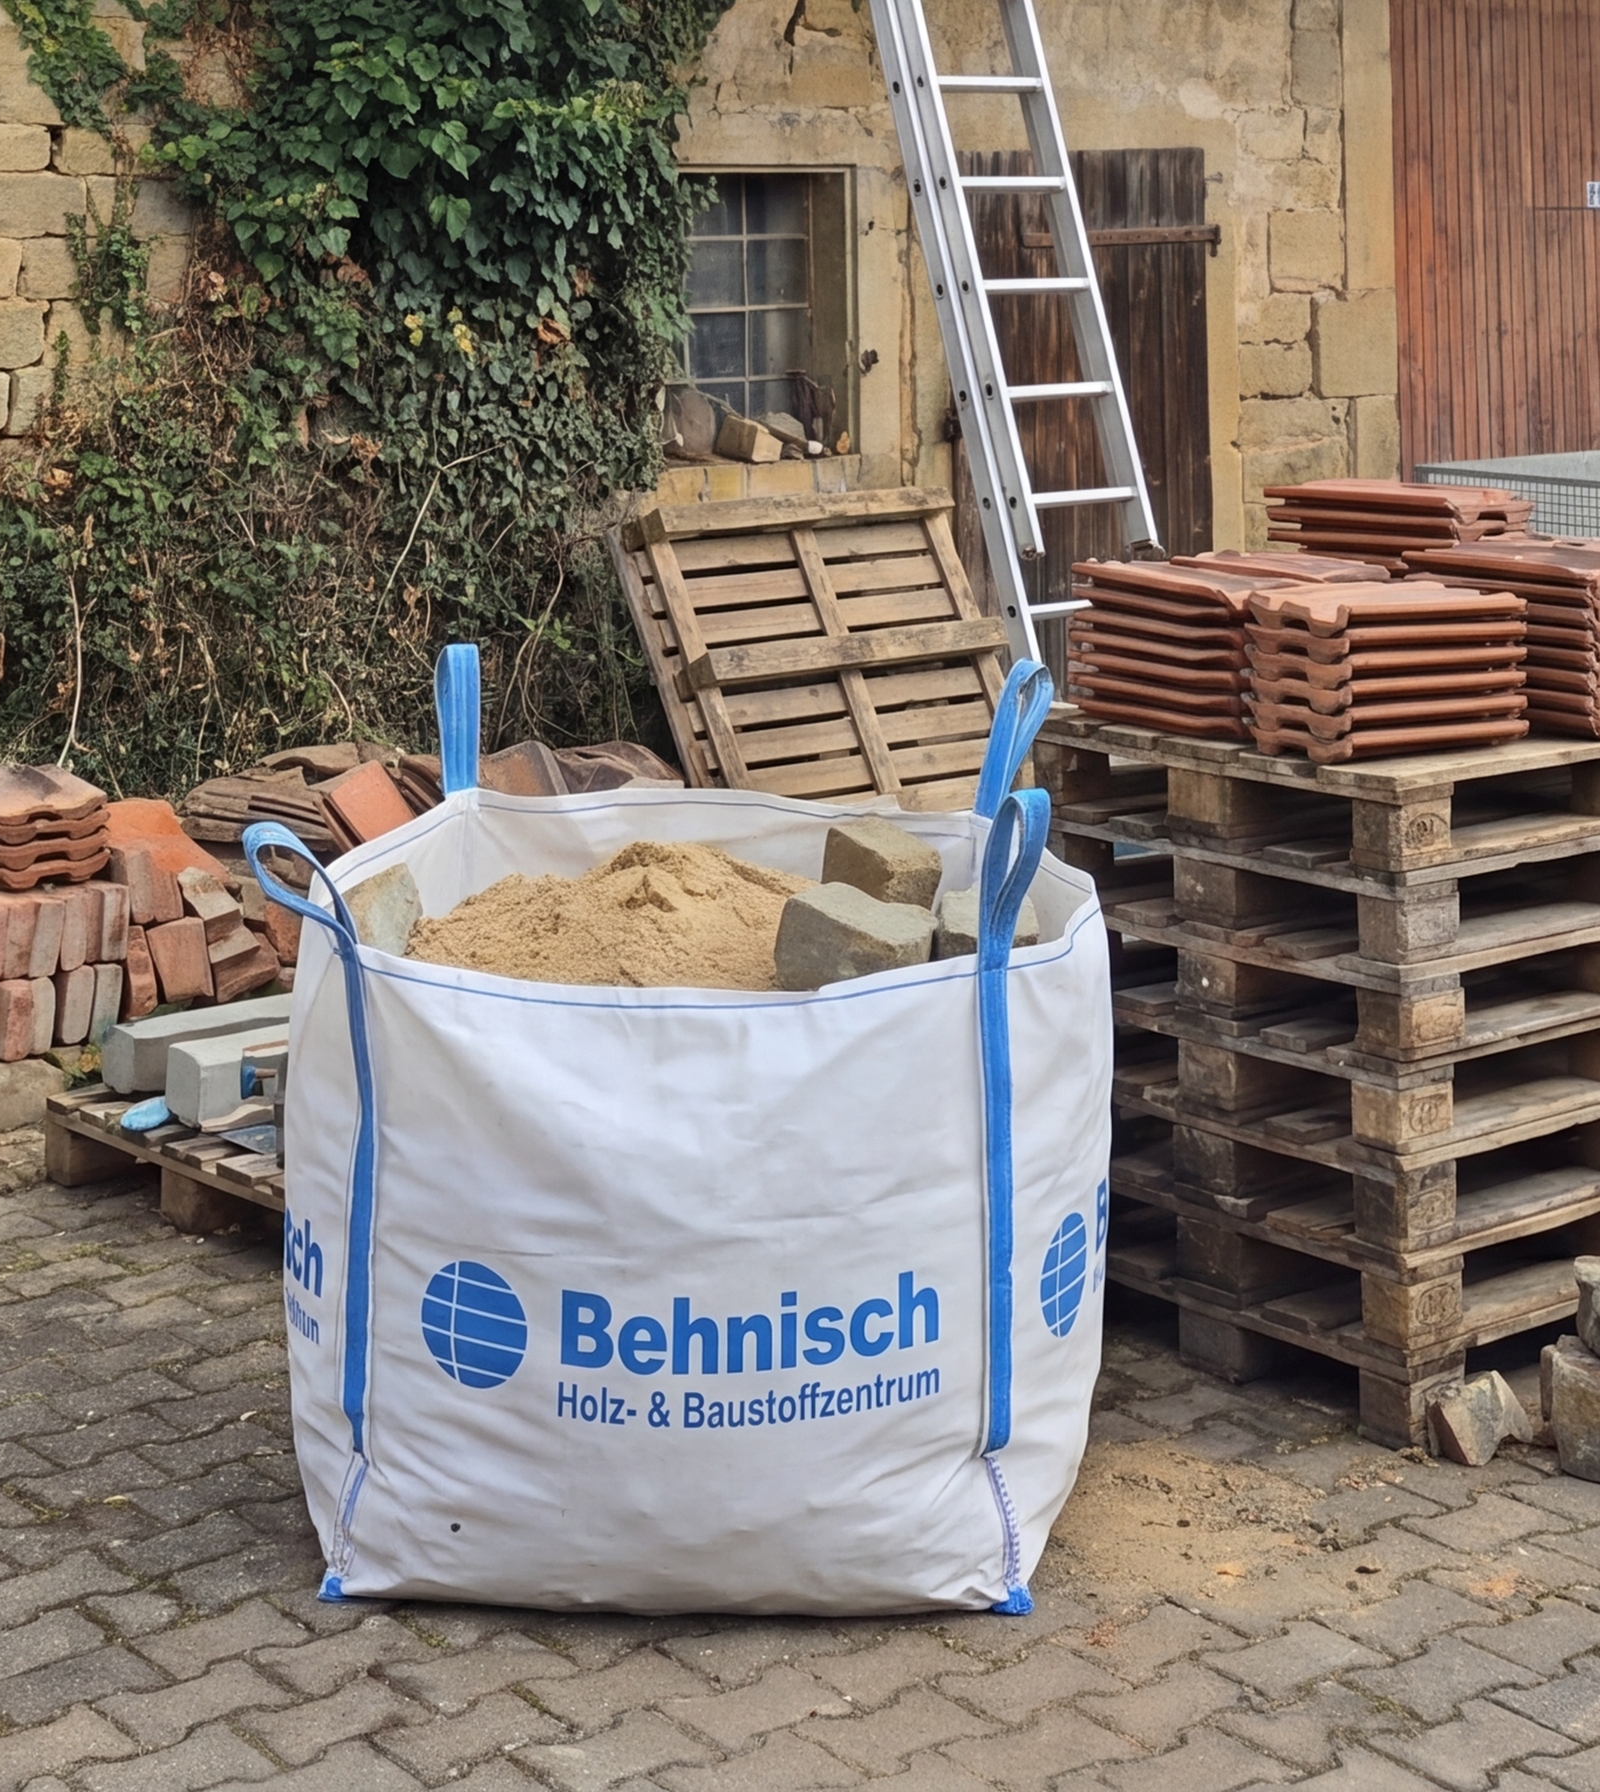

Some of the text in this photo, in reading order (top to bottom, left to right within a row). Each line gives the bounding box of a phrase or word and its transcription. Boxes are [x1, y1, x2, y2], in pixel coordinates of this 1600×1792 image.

[559, 1270, 941, 1376] Behnisch
[556, 1367, 941, 1429] Holz- & Baustoffzentrum
